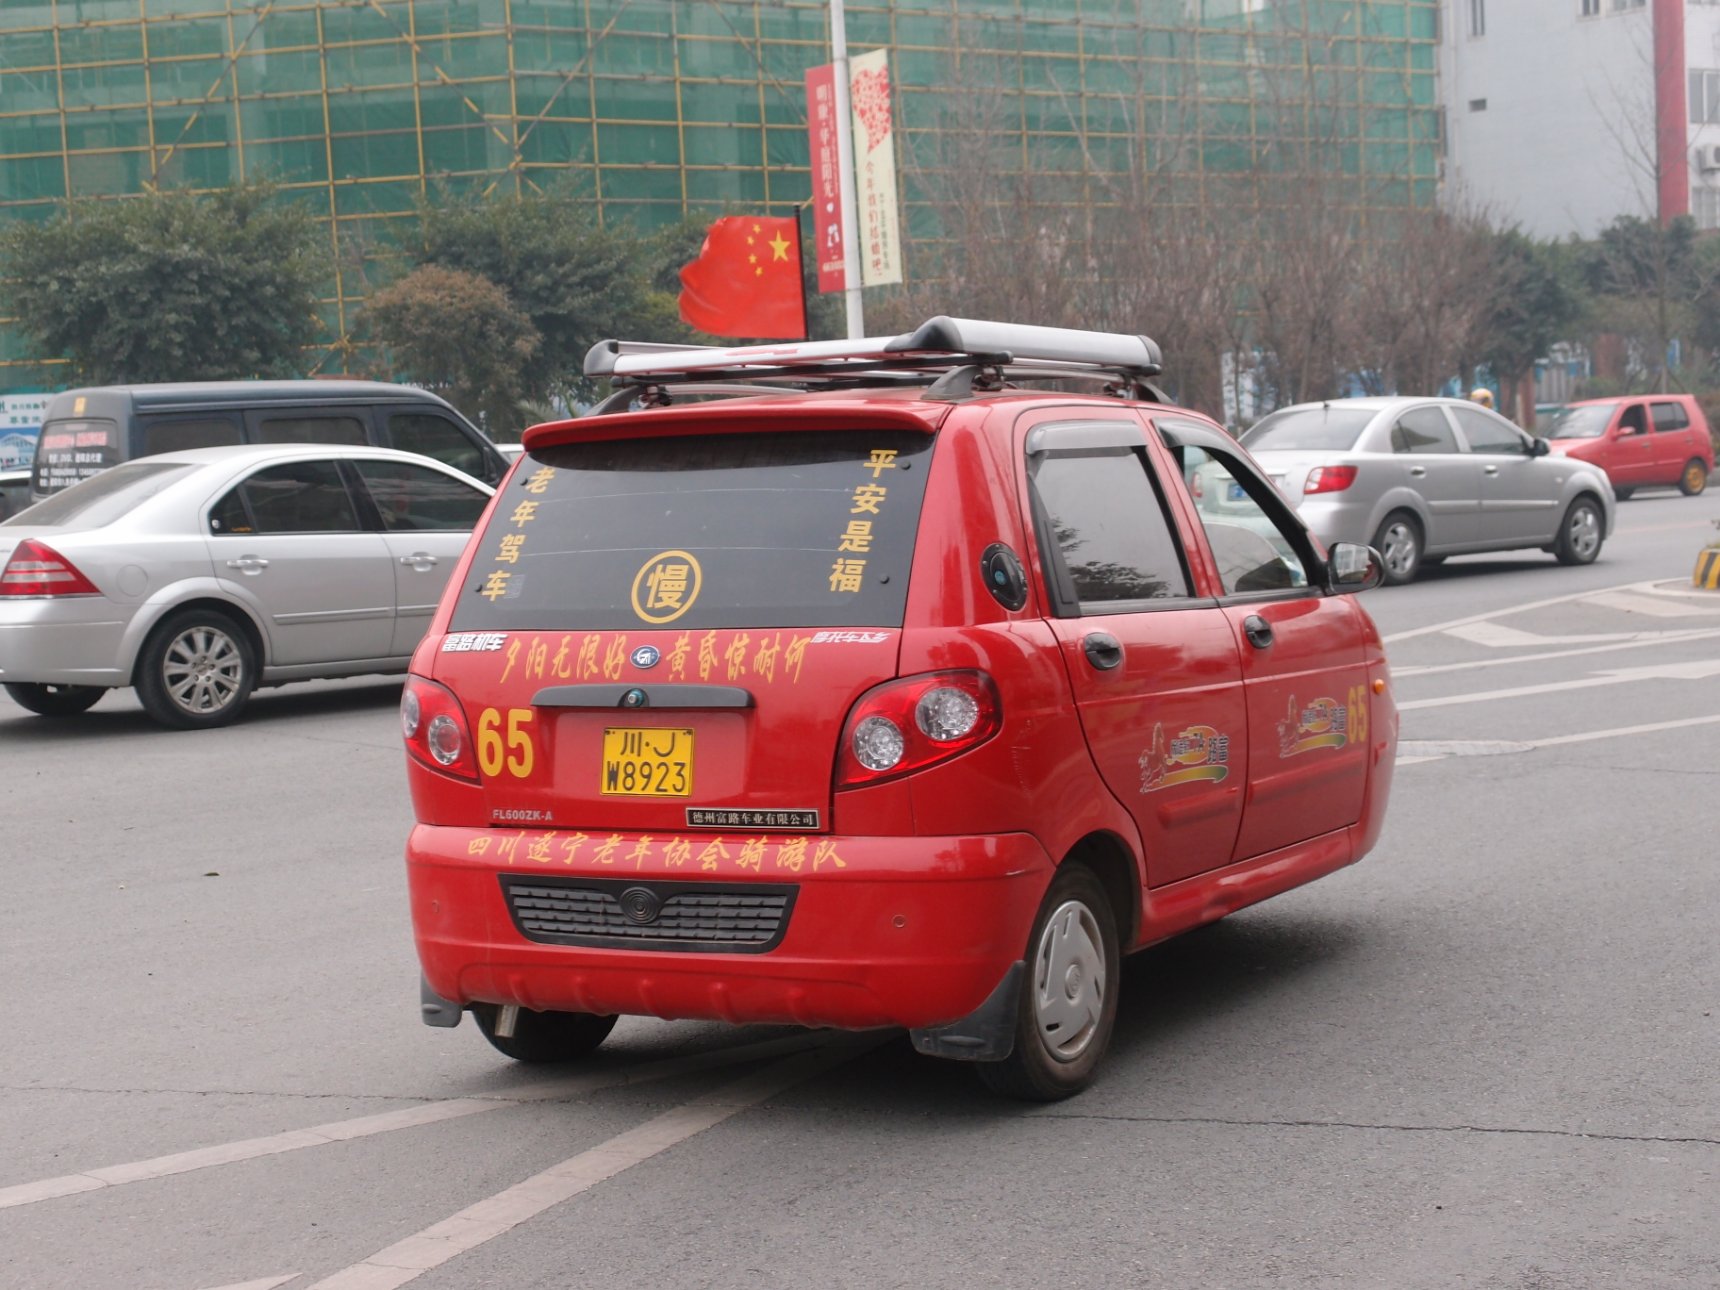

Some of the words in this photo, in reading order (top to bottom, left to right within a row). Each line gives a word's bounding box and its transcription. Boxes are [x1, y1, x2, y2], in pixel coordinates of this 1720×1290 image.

[481, 466, 556, 602] 老年驾车
[828, 449, 898, 593] 平安是福
[645, 564, 689, 610] 慢
[441, 632, 508, 652] 富路机车
[499, 633, 628, 684] 夕阳无限好
[810, 630, 892, 644] 摩托车下乡
[1348, 686, 1367, 743] 65
[477, 707, 533, 778] 65
[606, 760, 686, 793] W8923
[692, 811, 814, 826] 德州富路车业有限公司
[467, 831, 847, 872] 四川遂宁老年协会骑游队
